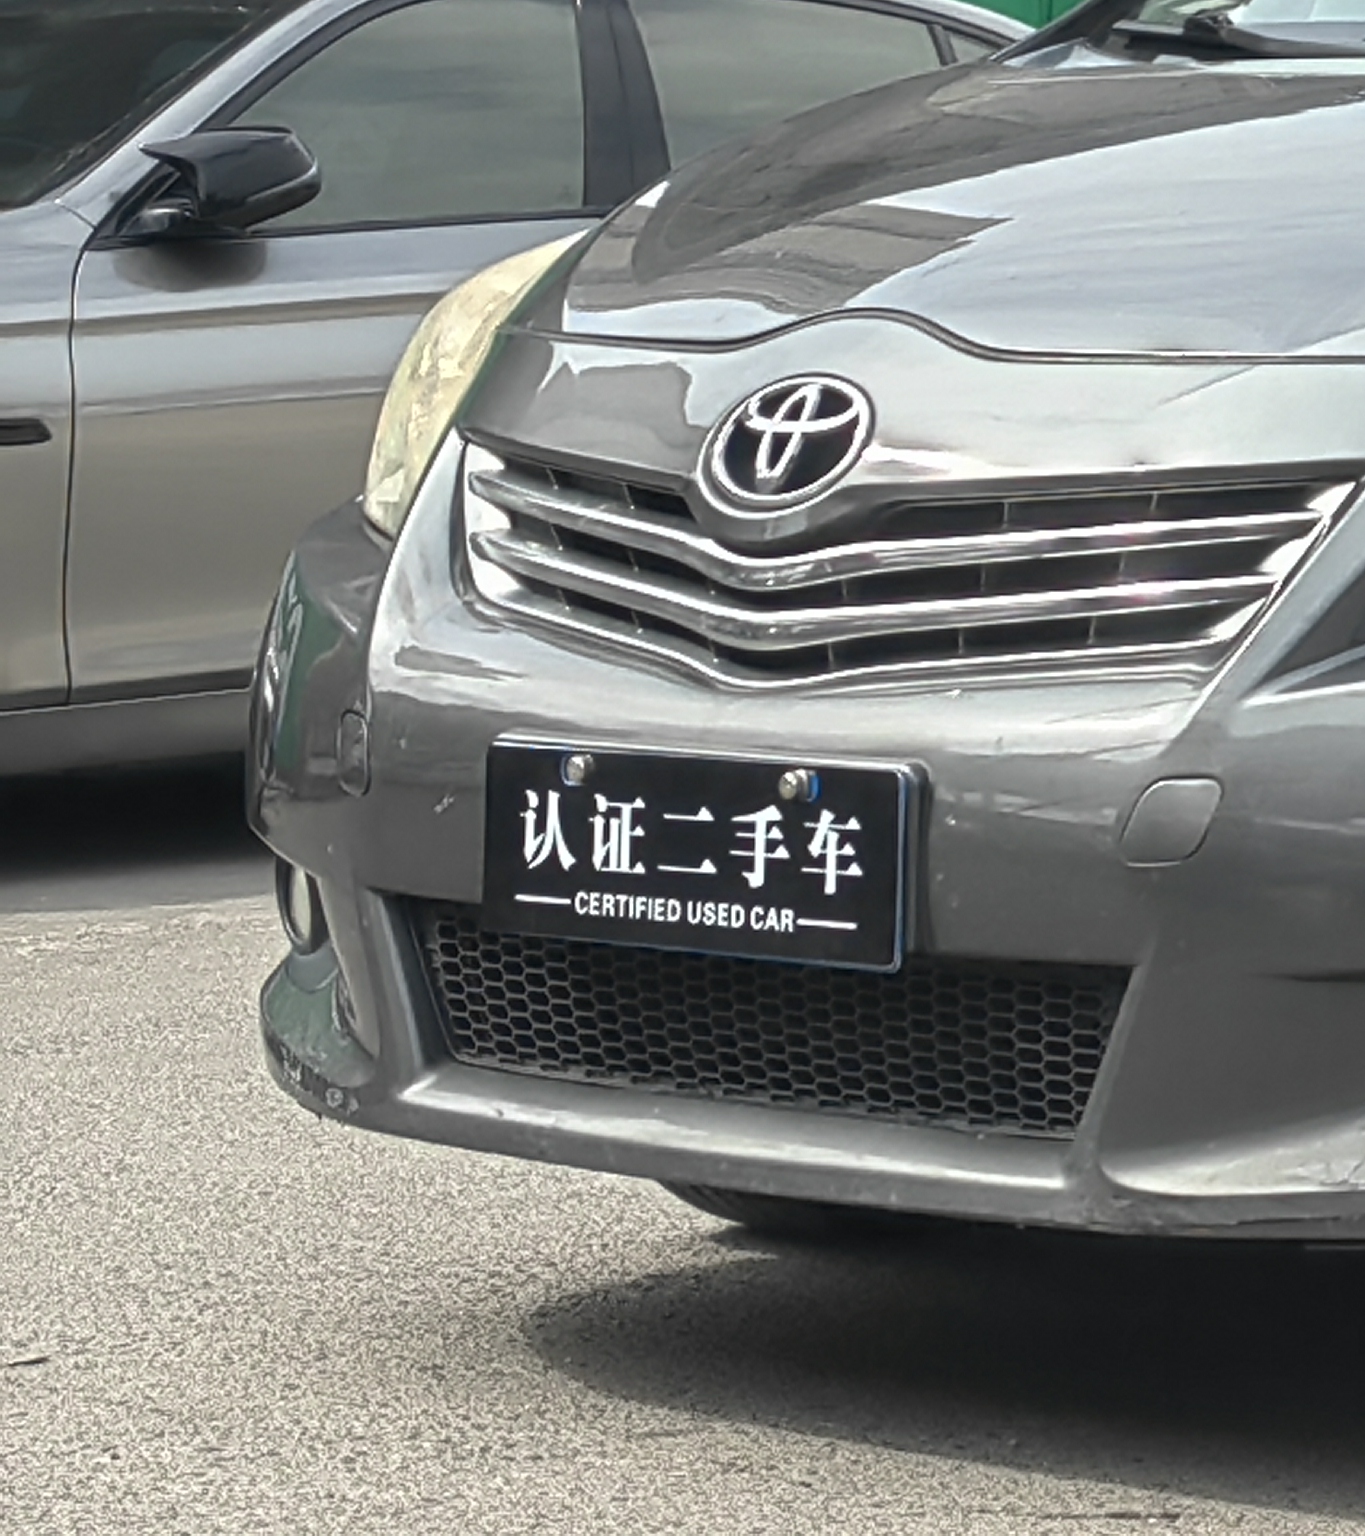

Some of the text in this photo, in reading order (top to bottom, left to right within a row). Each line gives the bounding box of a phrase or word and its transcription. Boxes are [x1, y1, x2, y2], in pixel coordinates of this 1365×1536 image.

[518, 788, 864, 896] 认证二手车
[573, 891, 795, 933] CERTIFIED USED CAR
